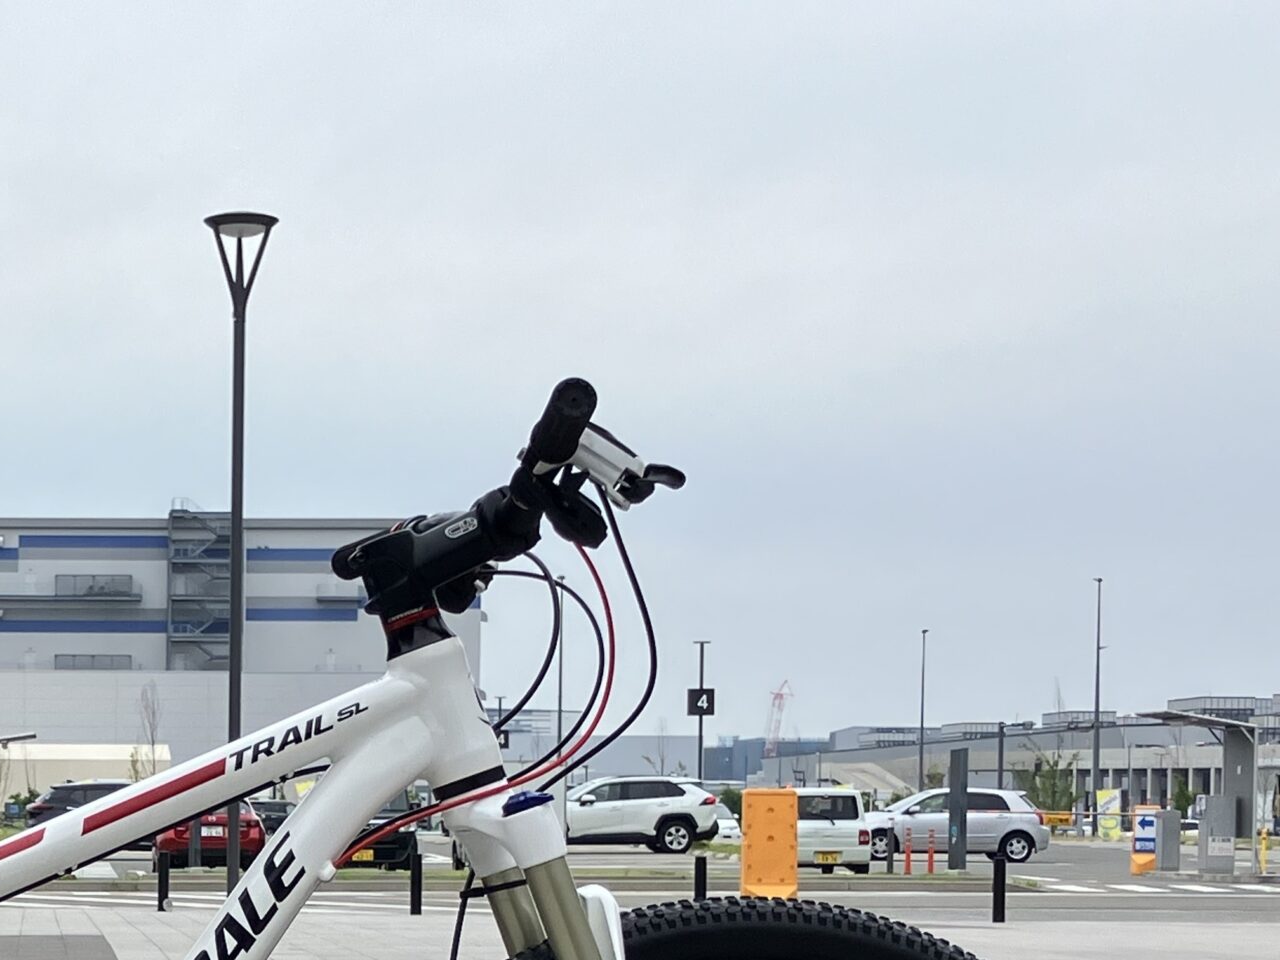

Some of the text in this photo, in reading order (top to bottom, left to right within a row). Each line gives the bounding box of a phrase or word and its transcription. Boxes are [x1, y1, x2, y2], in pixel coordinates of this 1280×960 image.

[697, 694, 709, 710] 4
[229, 702, 369, 771] TRAIL SL
